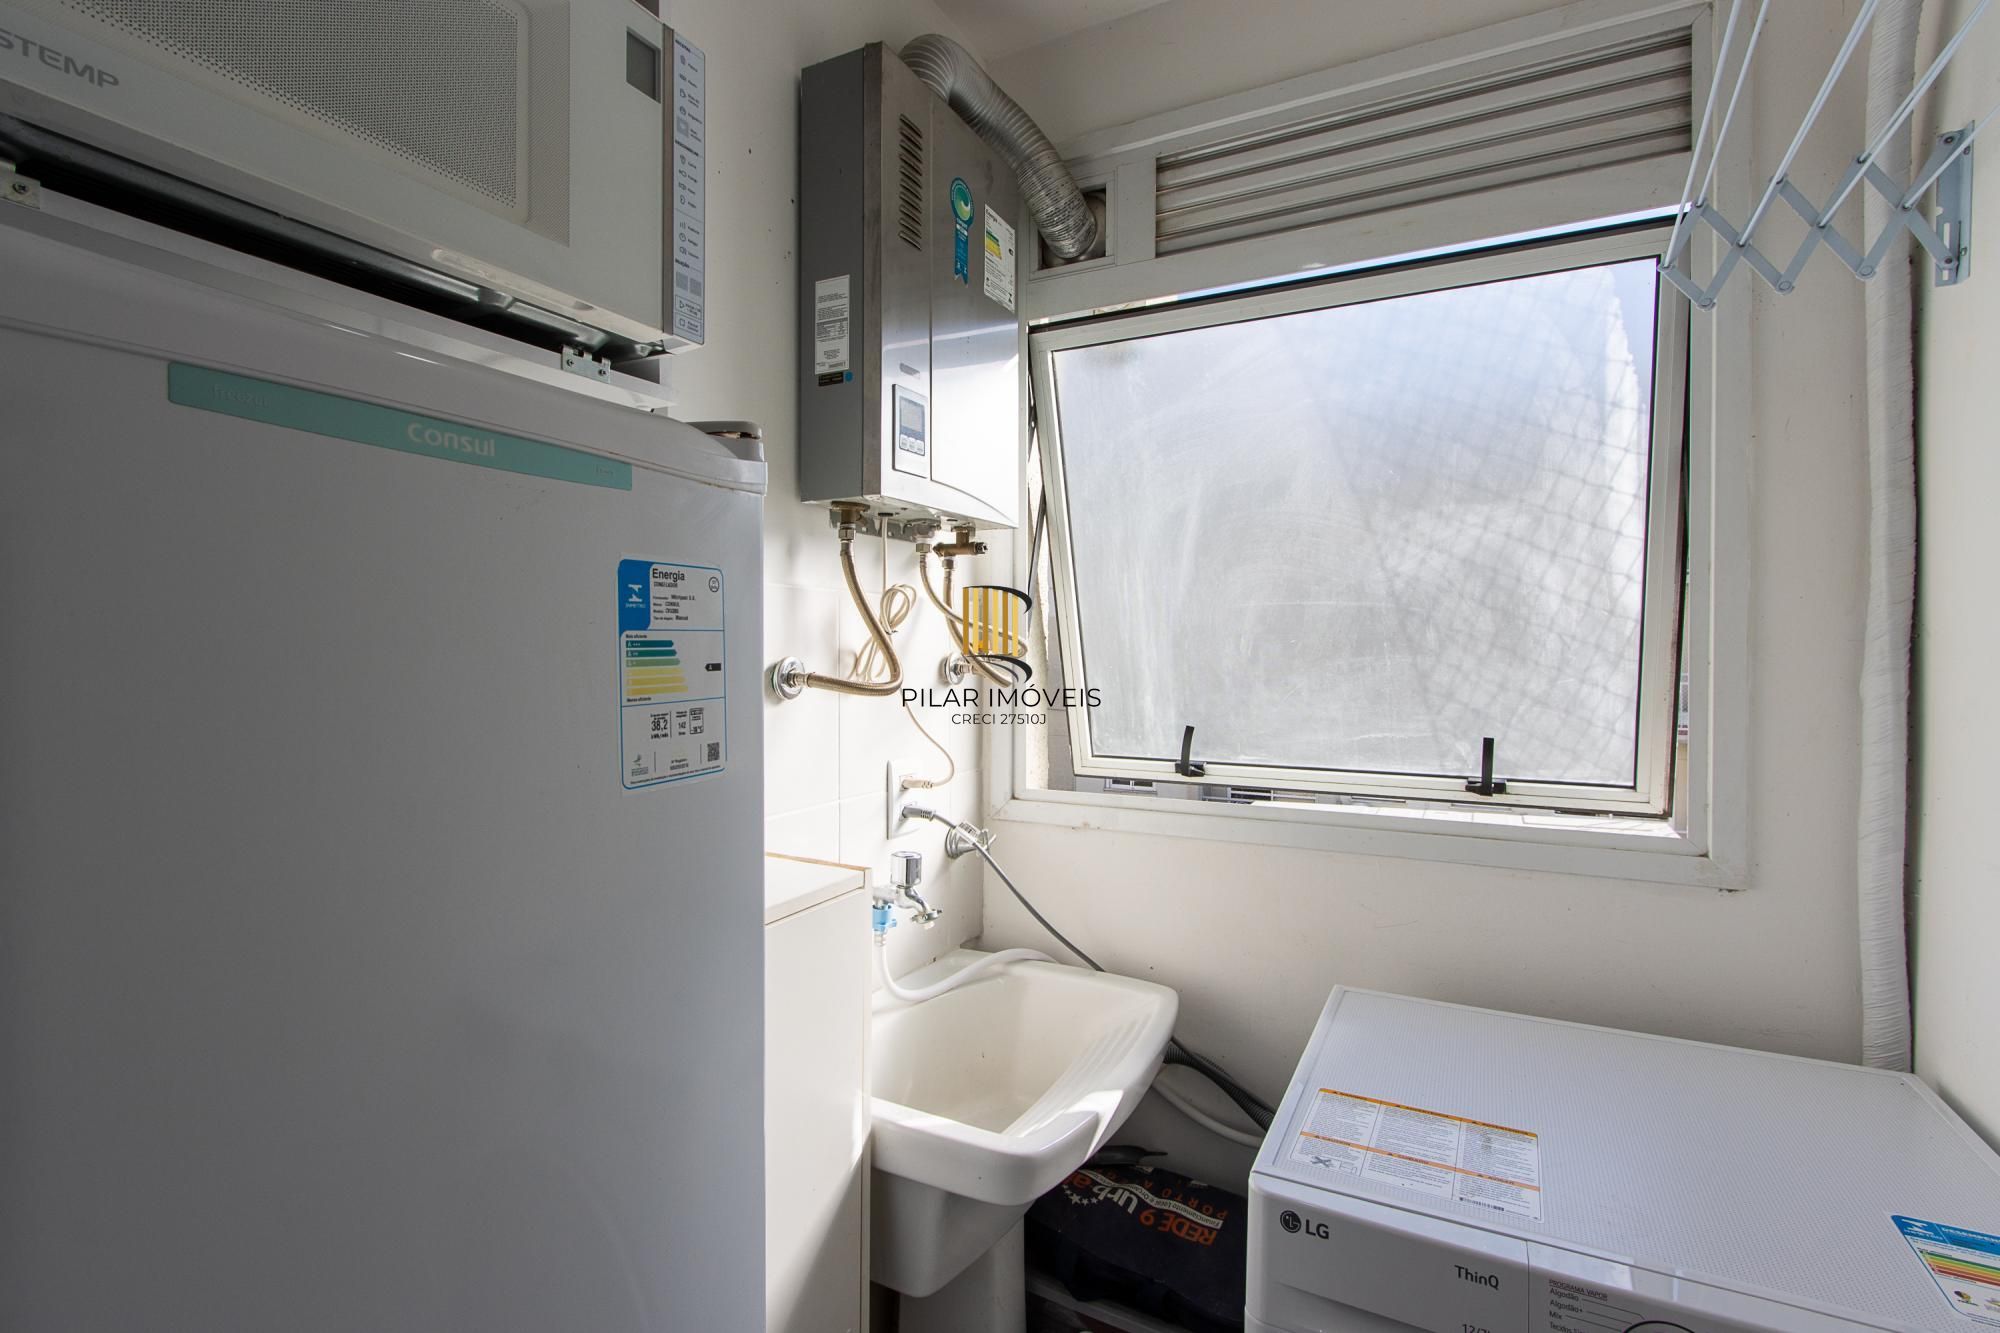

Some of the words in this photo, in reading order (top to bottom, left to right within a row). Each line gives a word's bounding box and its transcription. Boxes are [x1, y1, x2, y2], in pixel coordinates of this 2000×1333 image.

[0, 27, 119, 89] STEMP
[405, 421, 496, 458] Consul
[652, 568, 686, 583] Energia
[651, 719, 668, 732] 38,2
[1139, 1208, 1157, 1227] 9
[1158, 1211, 1217, 1247] REDE
[1305, 1219, 1330, 1239] LG
[1454, 1265, 1500, 1290] ThinQ
[1549, 1278, 1585, 1294] PROGRAMA
[1586, 1288, 1608, 1301] VAPOR
[1548, 1310, 1562, 1320] Mix
